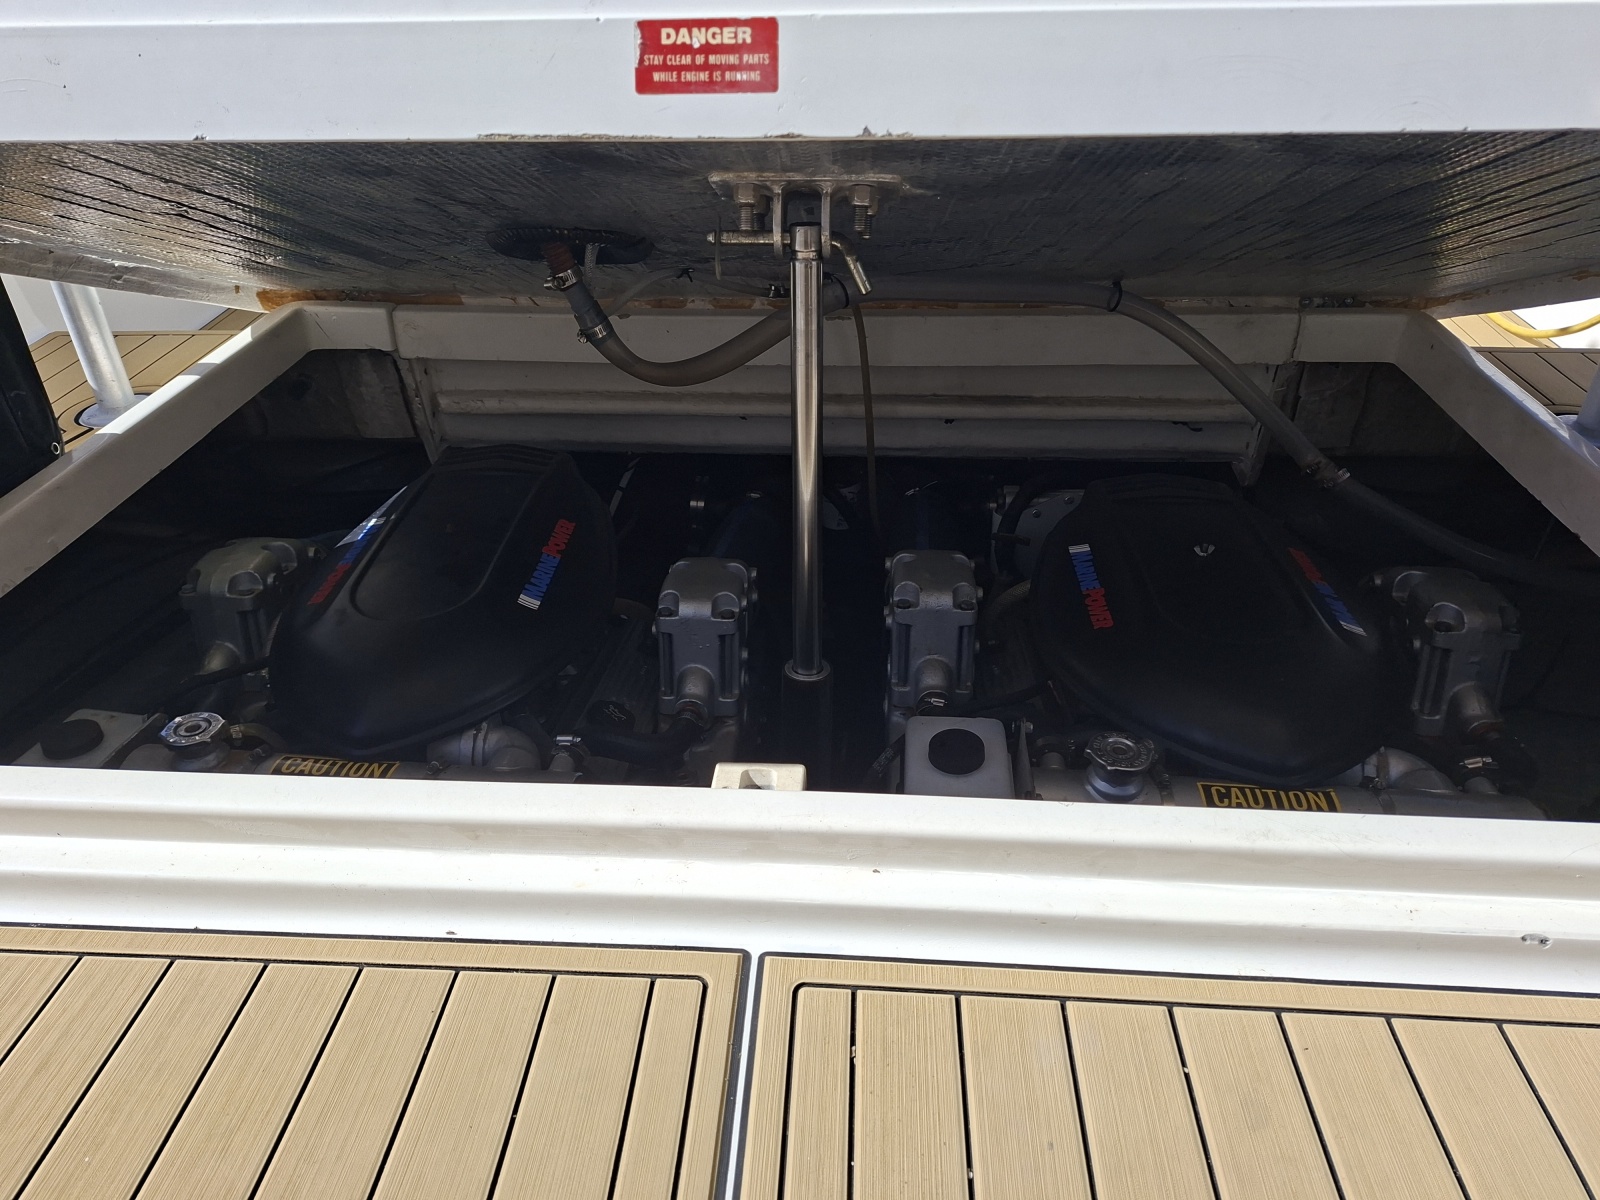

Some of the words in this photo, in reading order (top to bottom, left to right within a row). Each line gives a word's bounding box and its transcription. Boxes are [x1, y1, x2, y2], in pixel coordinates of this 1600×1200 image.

[660, 26, 752, 46] DANGER
[643, 54, 664, 66] STAY
[667, 54, 692, 65] CLEAR
[695, 54, 705, 65] OF
[708, 53, 740, 65] MOVING
[743, 53, 770, 65] PARTS
[652, 71, 678, 82] WHILE
[681, 71, 710, 82] ENGINE
[713, 71, 722, 82] IS
[725, 70, 761, 82] RUNNING
[280, 757, 389, 779] CAUTION
[1210, 786, 1330, 812] CAUTION
